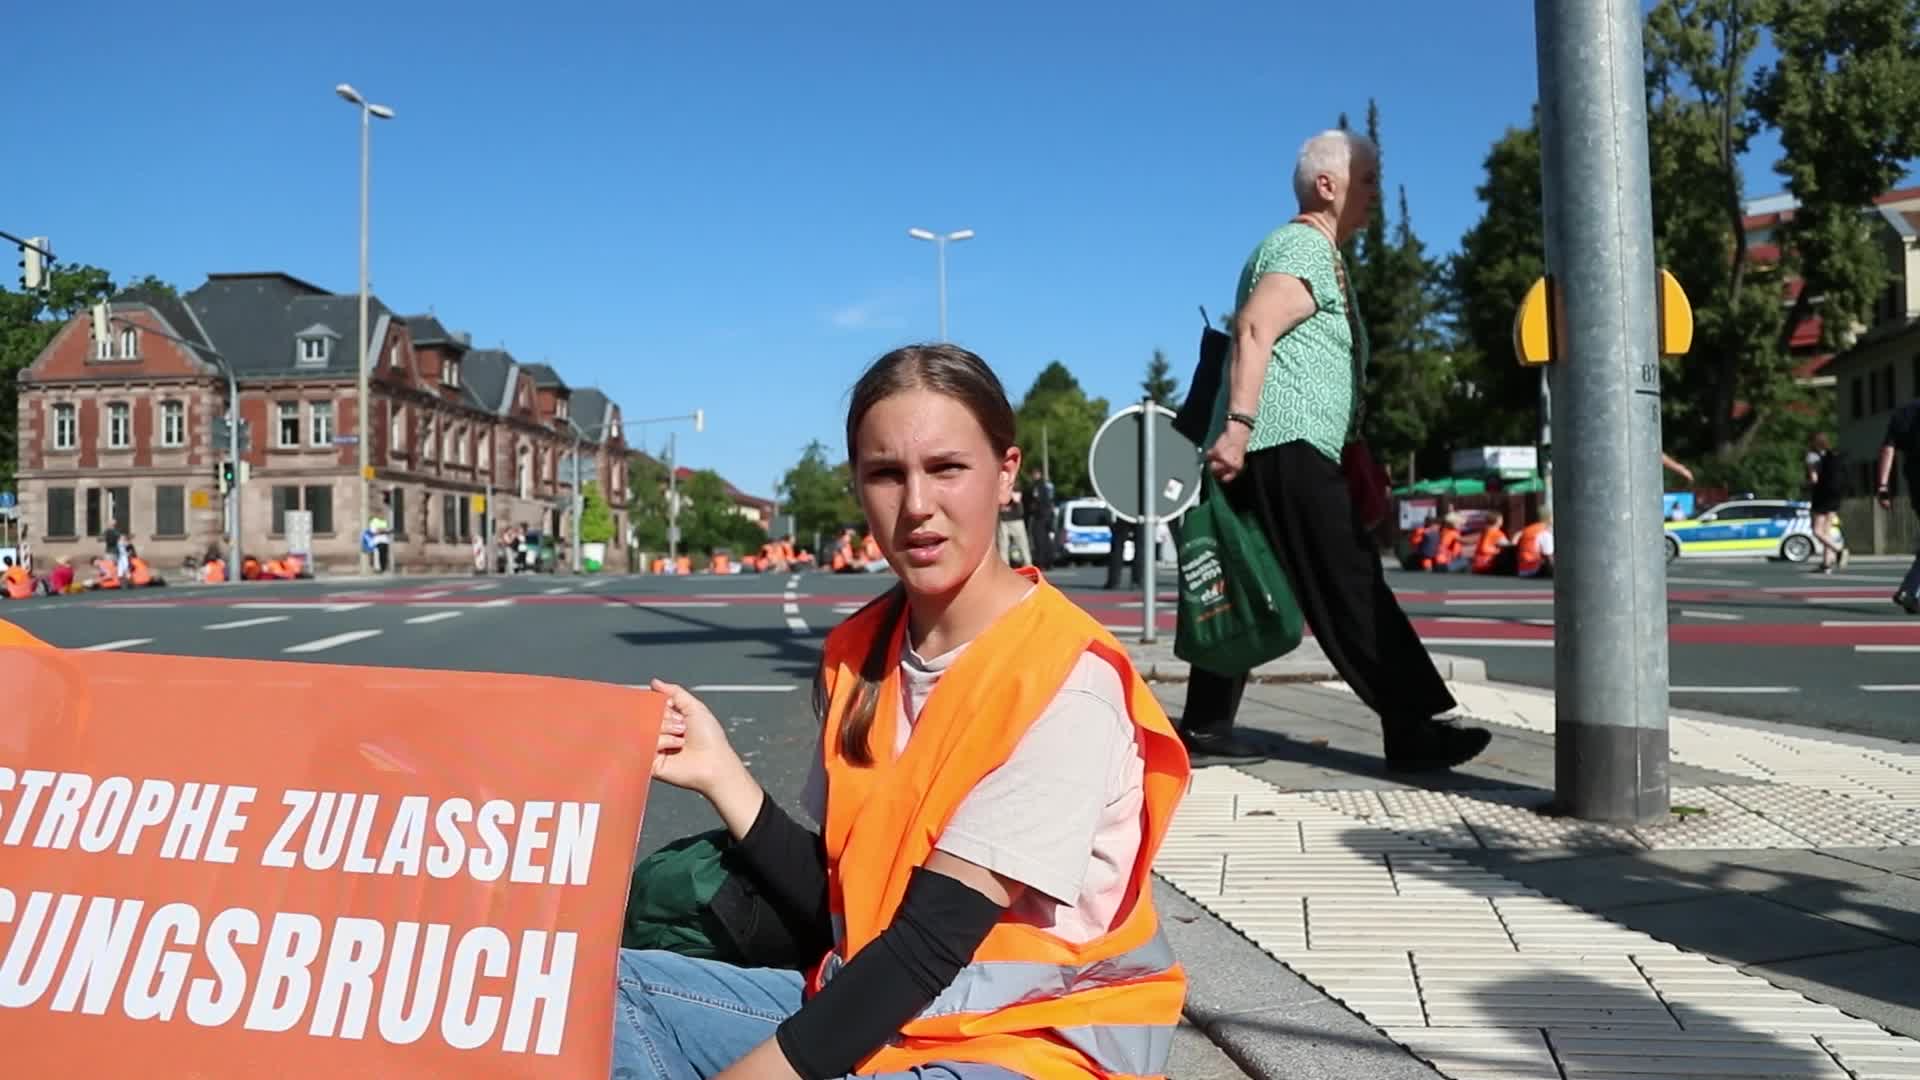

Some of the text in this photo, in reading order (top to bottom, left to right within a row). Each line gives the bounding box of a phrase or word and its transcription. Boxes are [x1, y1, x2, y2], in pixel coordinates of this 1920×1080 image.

[0, 767, 601, 886] TROPHE ZULASSEN
[0, 887, 578, 1056] UNGSBRUCH
